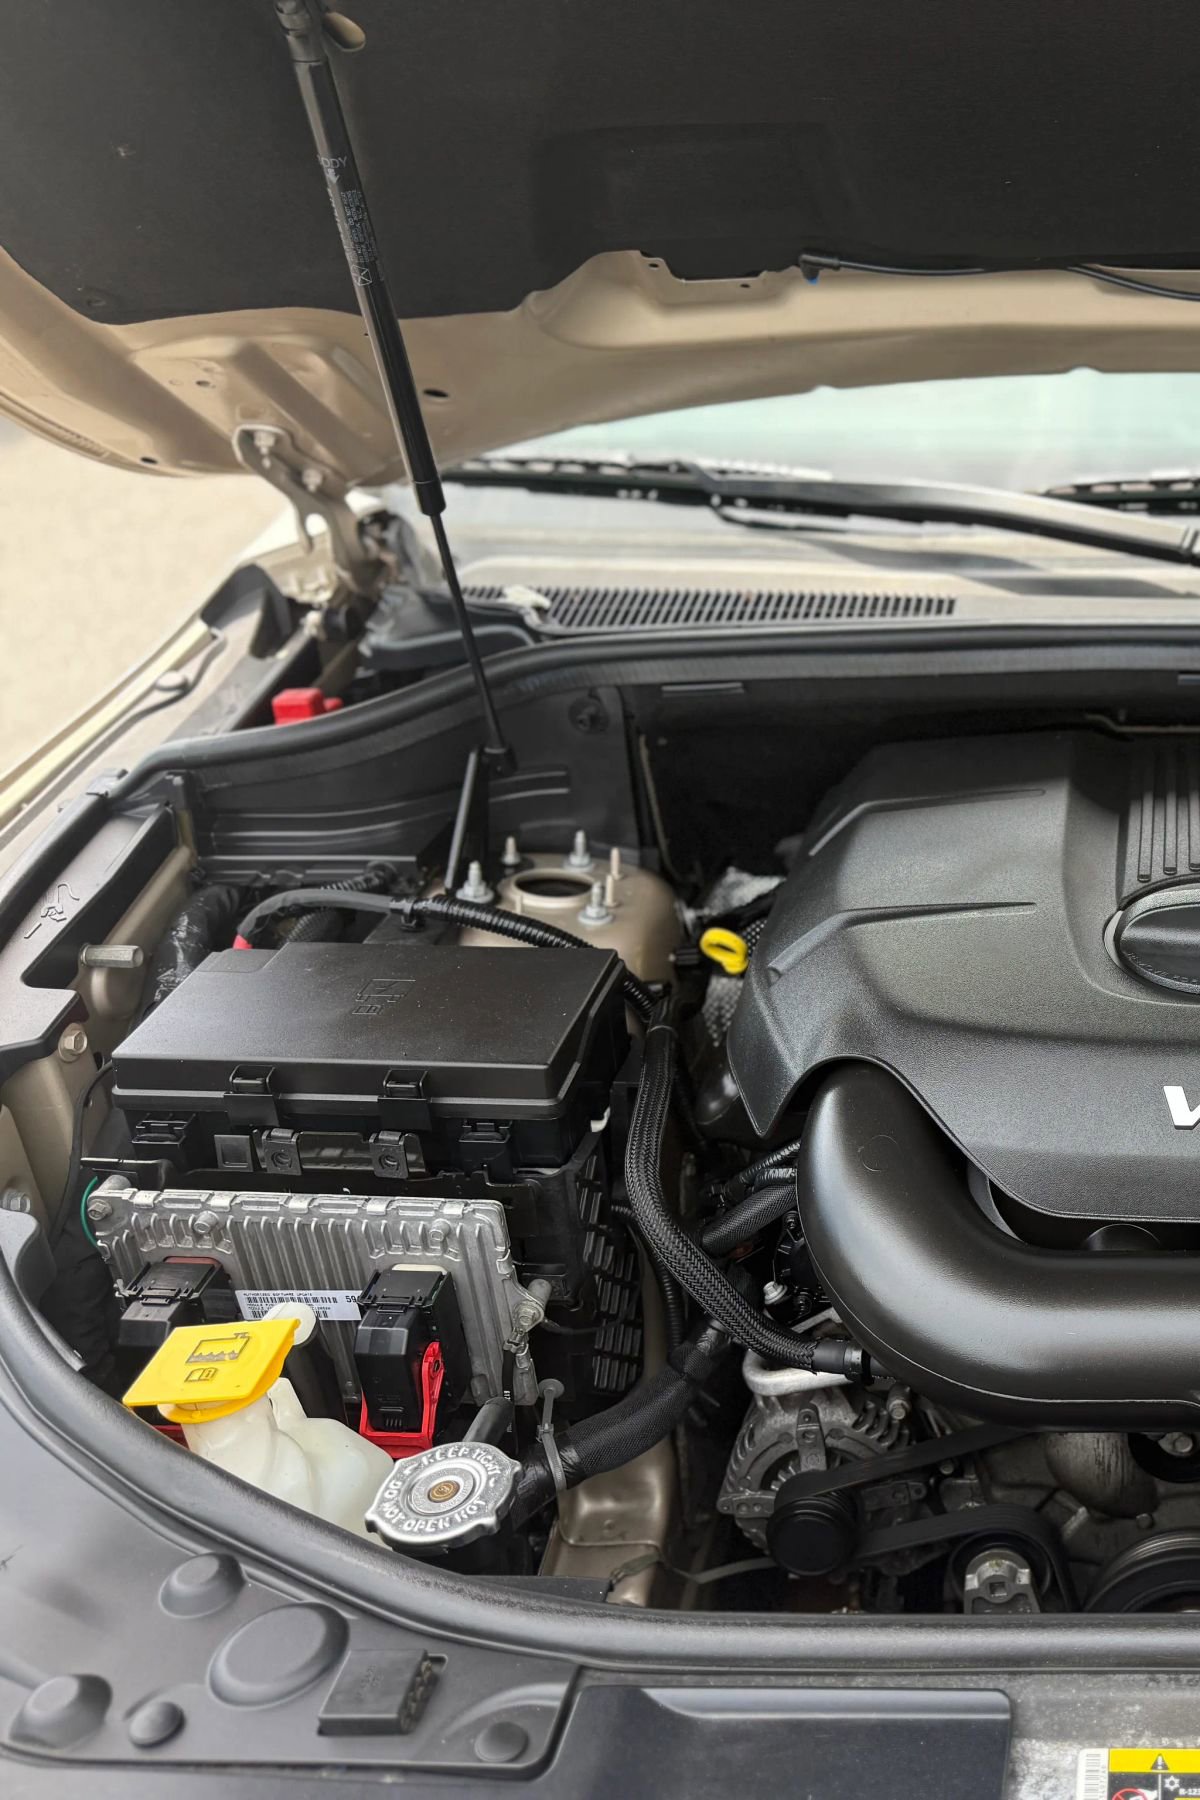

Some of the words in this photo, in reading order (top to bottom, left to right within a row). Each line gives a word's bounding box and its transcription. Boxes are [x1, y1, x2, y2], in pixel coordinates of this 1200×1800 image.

[345, 1295, 360, 1303] 59
[421, 1447, 470, 1466] KEEP
[471, 1447, 502, 1475] TIGHT
[384, 1480, 403, 1499] DO
[380, 1502, 406, 1524] NOT
[455, 1496, 487, 1524] HOT
[402, 1517, 451, 1533] OPEN
